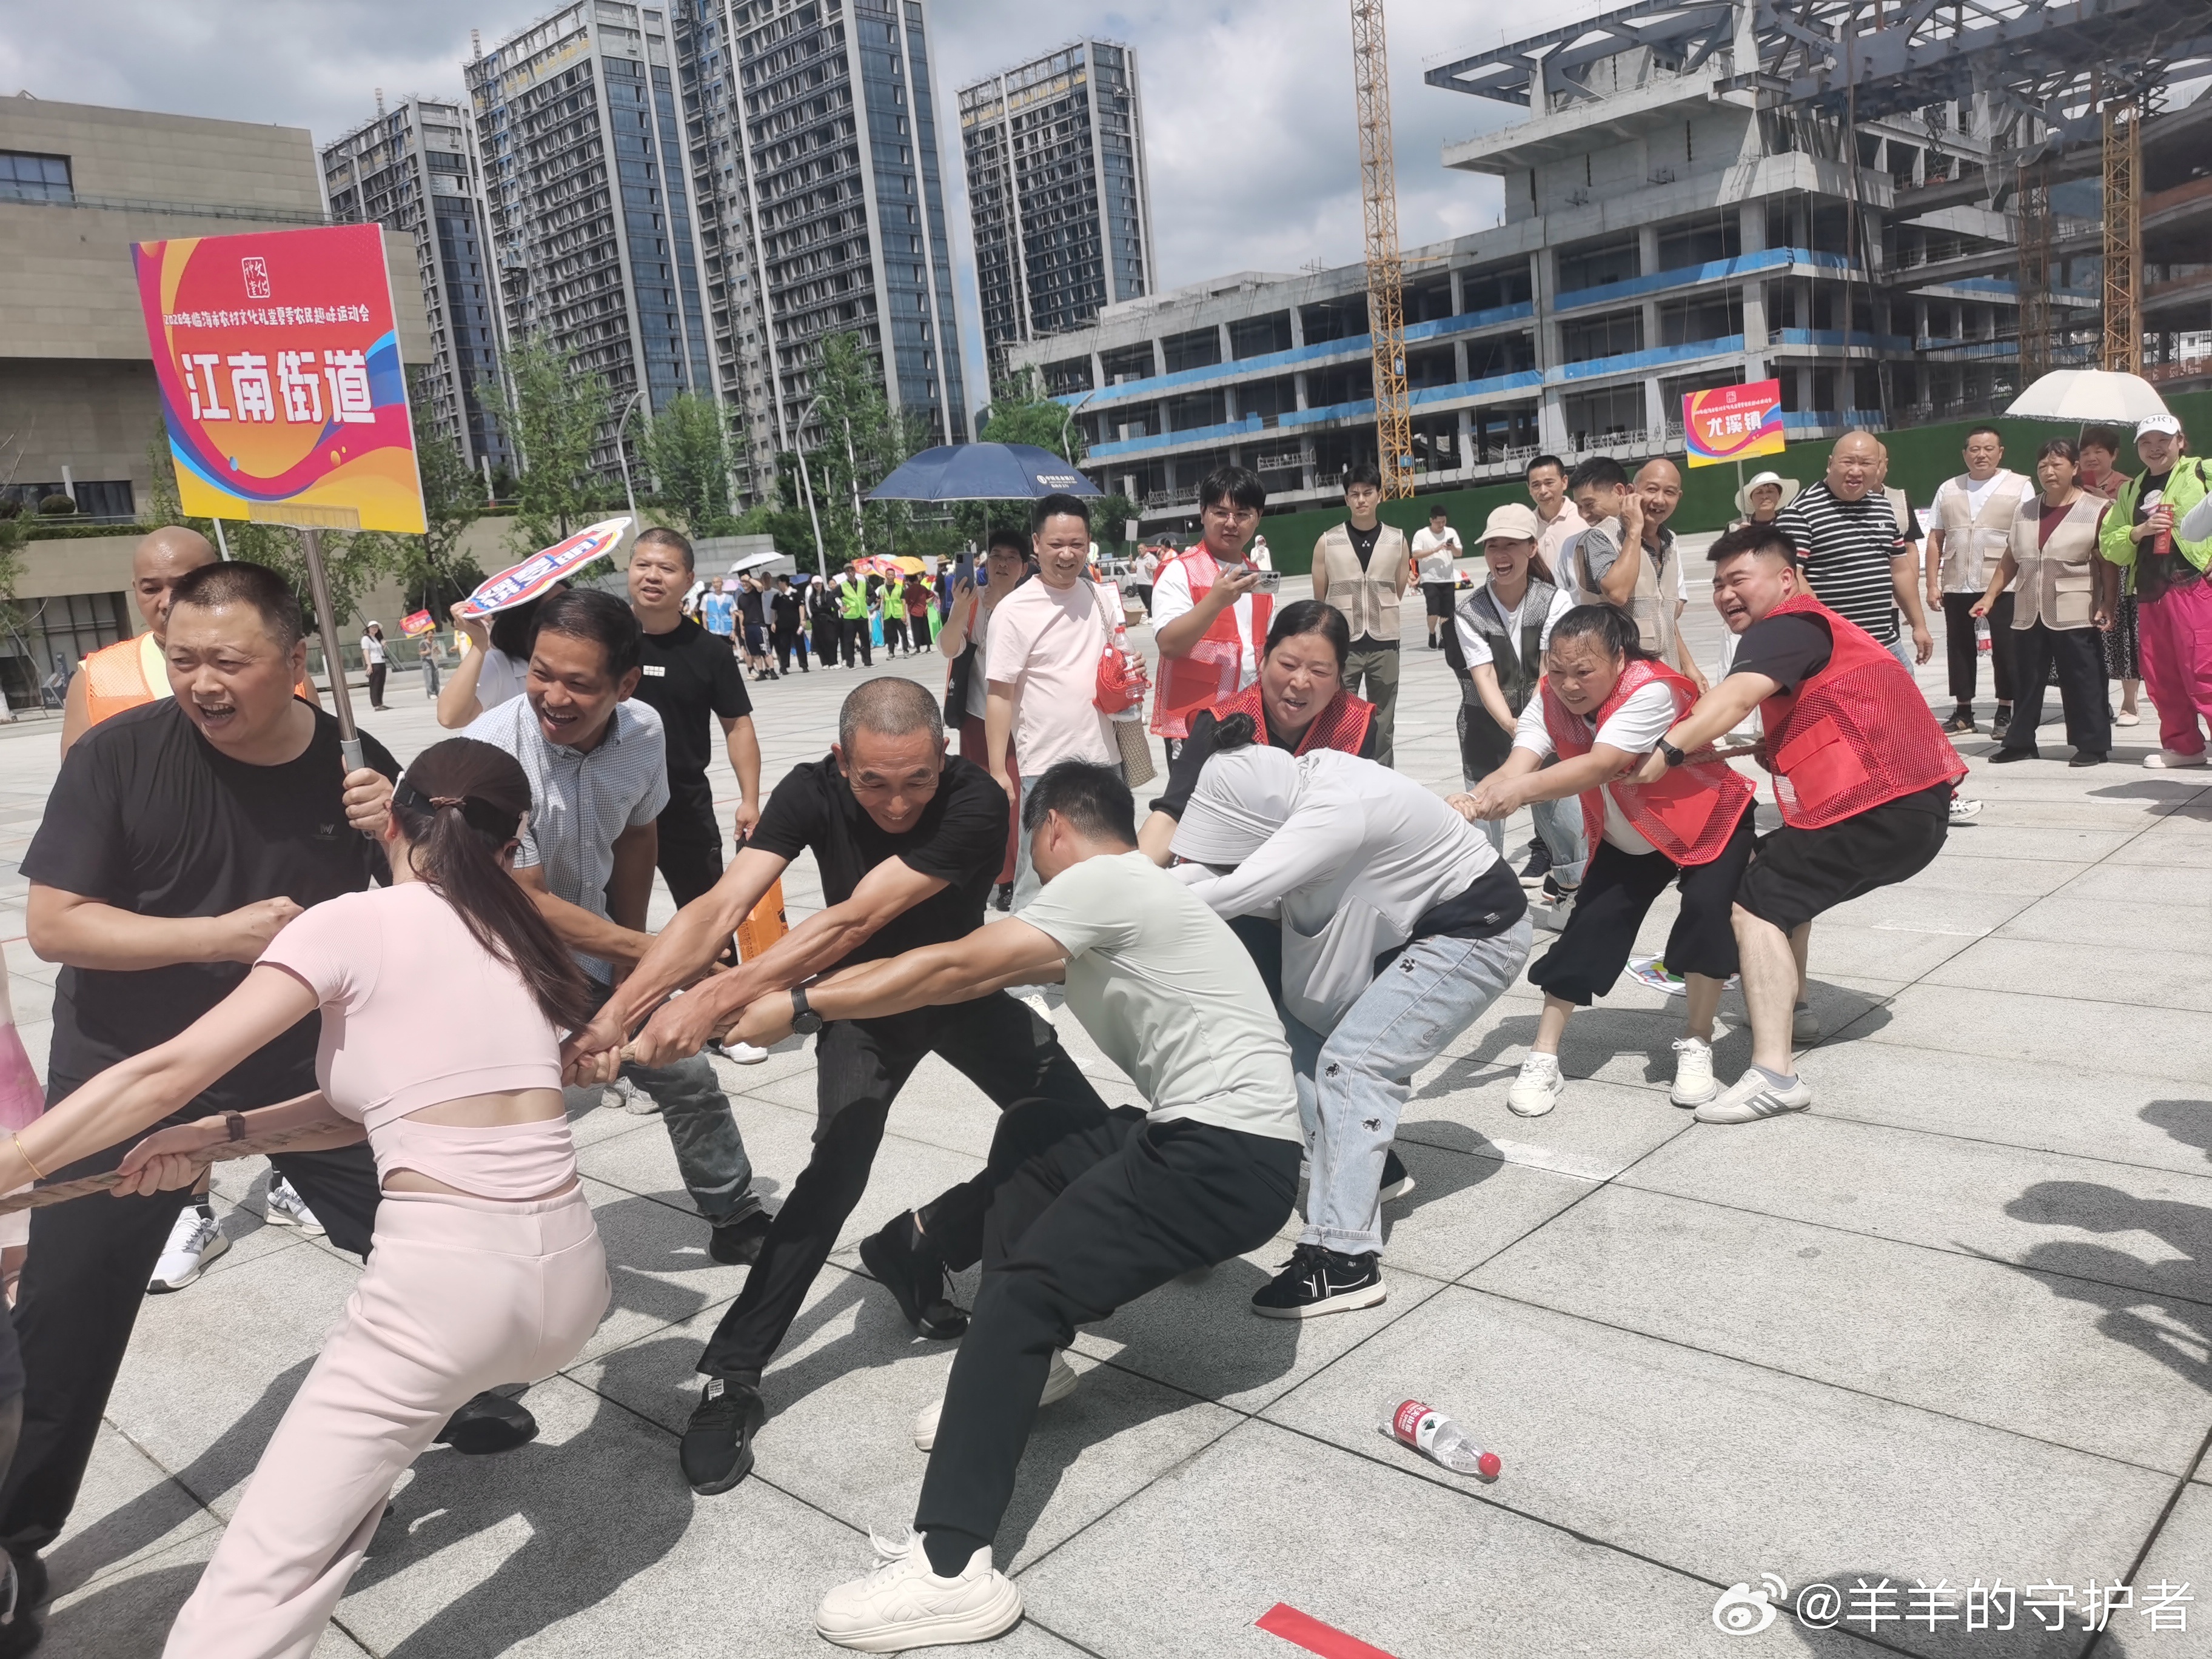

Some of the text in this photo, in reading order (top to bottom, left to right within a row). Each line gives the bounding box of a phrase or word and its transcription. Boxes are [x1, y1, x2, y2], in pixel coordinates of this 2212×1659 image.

[181, 349, 375, 423] 江南街道
[1706, 411, 1762, 438] 尤溪镇
